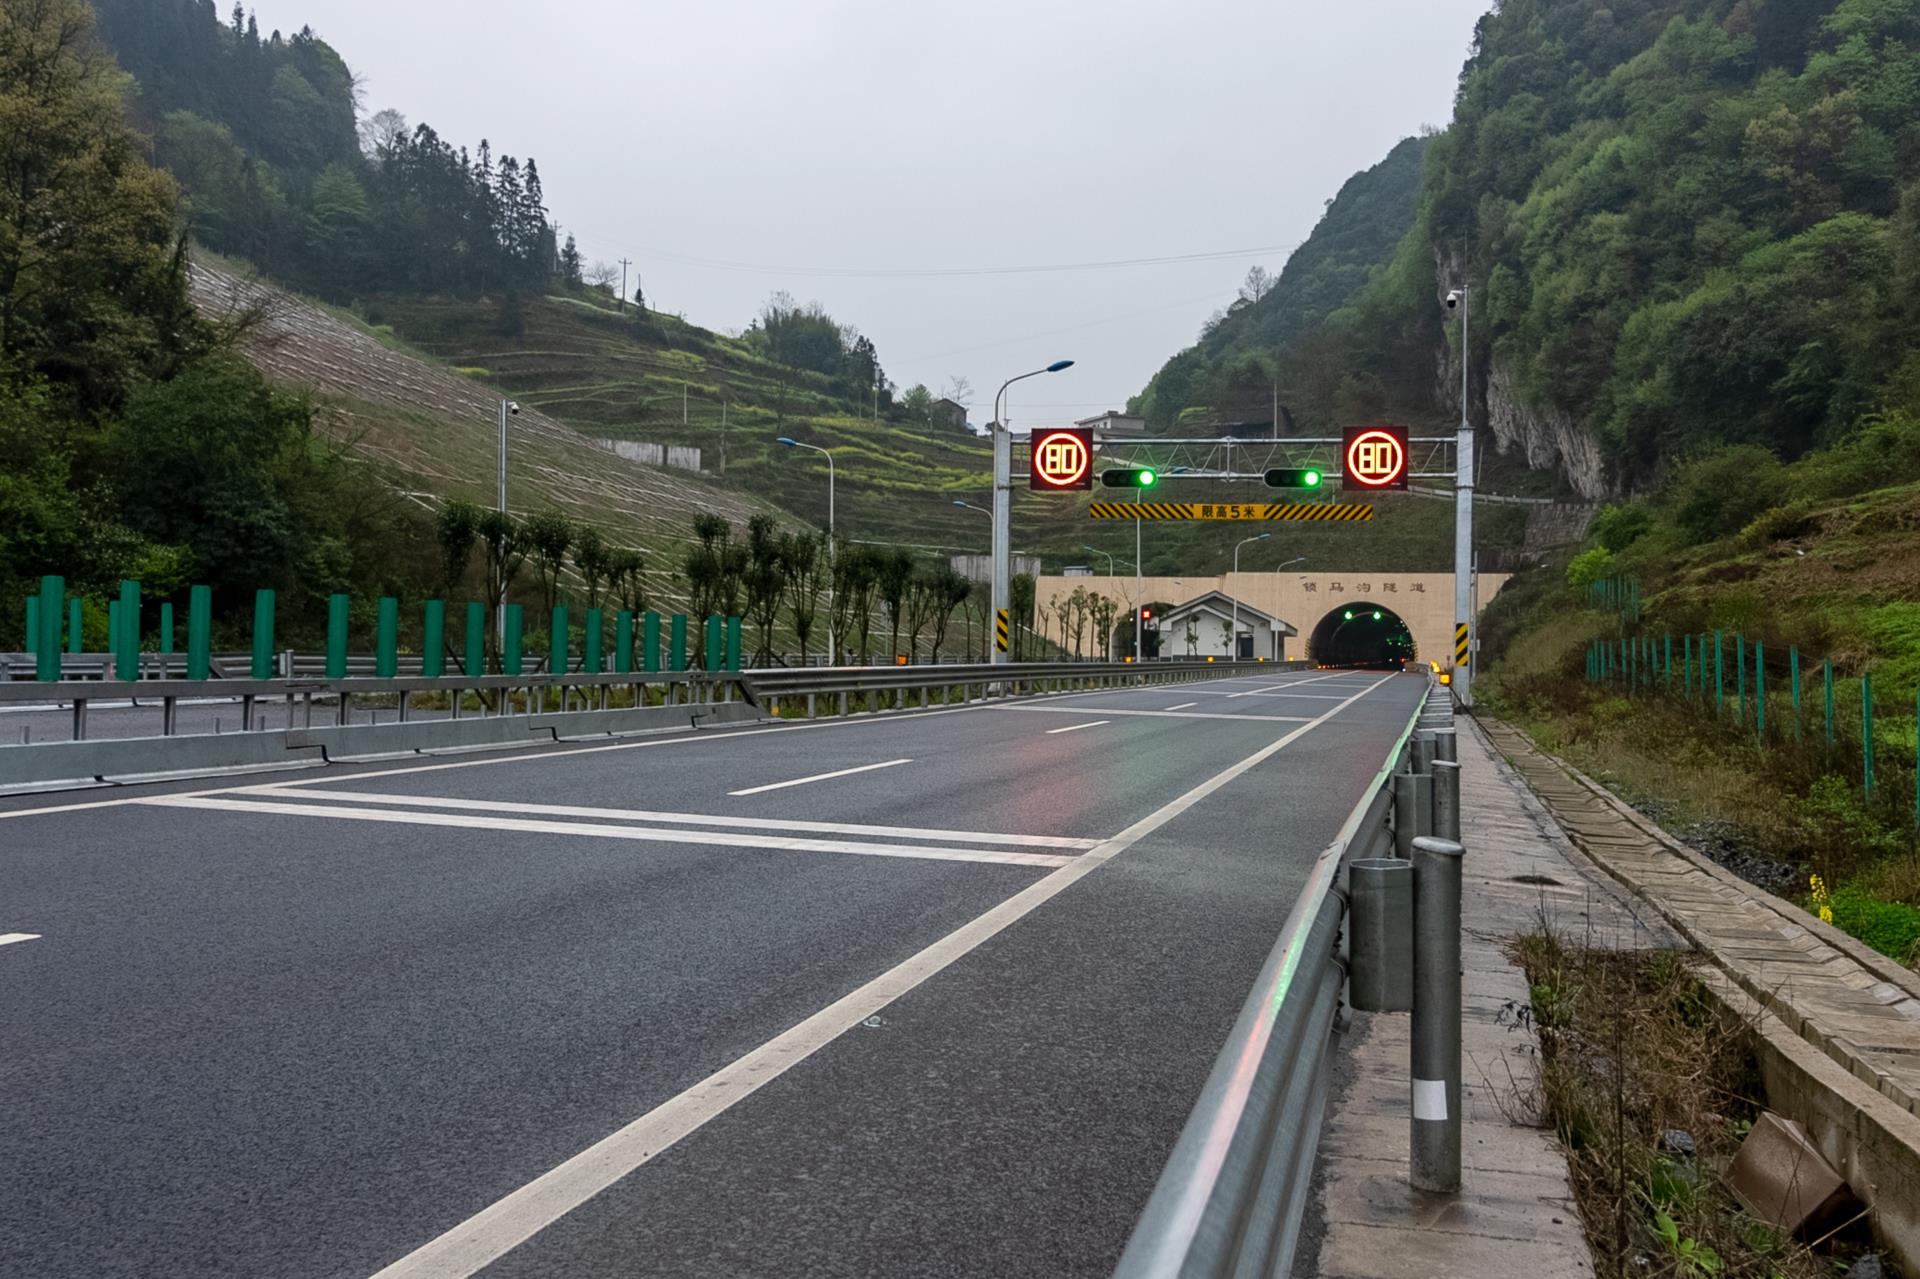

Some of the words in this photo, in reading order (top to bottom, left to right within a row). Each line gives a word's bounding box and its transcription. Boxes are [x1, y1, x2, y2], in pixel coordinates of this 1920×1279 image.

[1045, 444, 1077, 474] 80
[1358, 442, 1392, 474] 80
[1201, 505, 1256, 519] 限高5米
